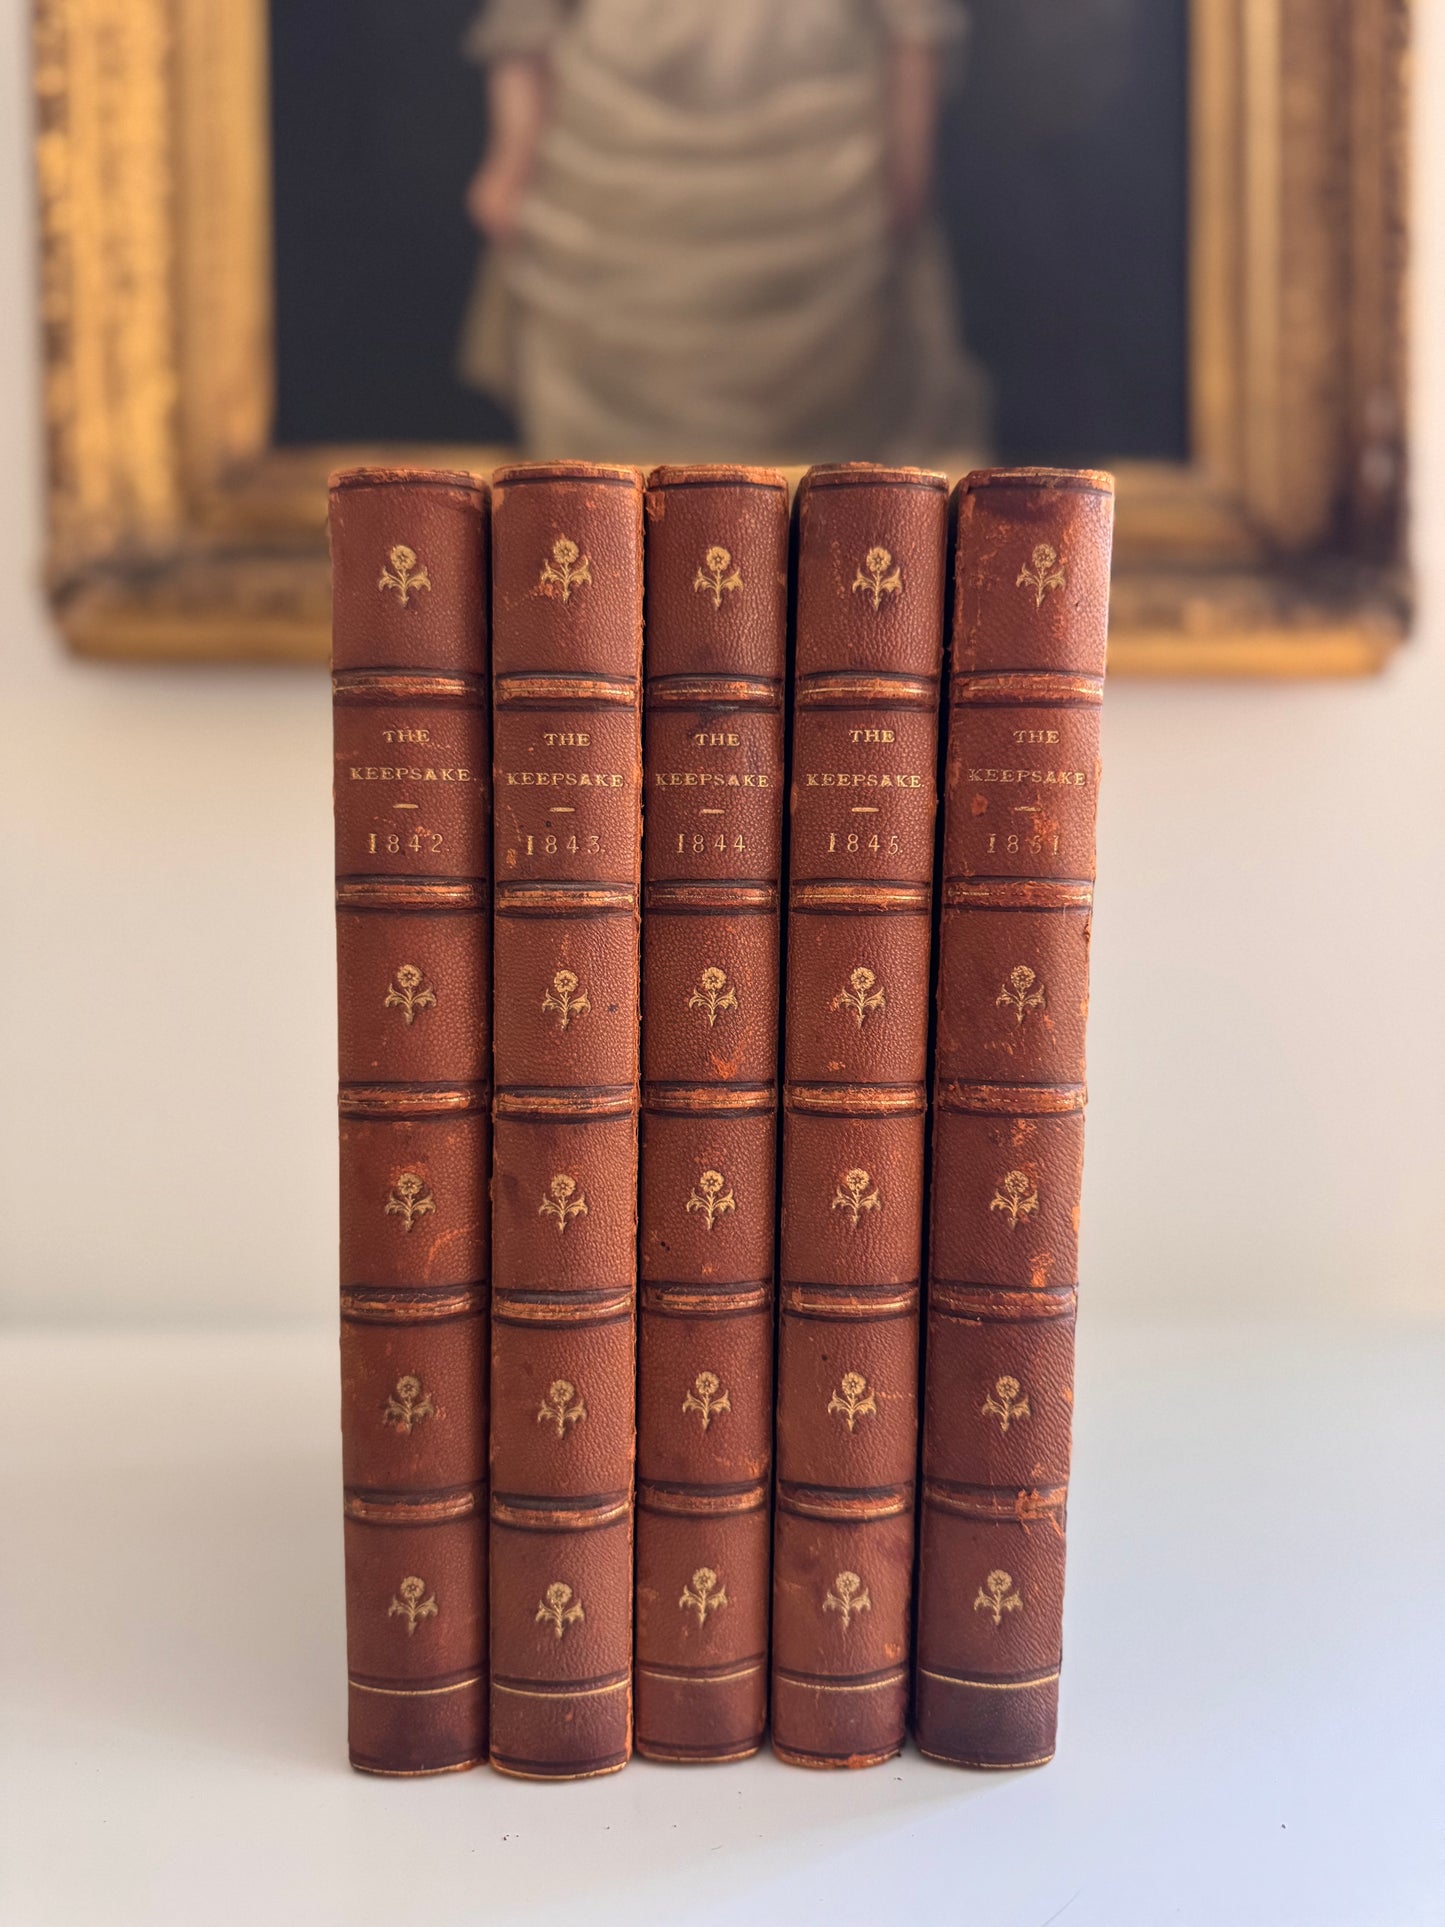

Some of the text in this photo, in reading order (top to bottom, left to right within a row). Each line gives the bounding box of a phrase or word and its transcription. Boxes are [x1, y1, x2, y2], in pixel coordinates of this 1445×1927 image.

[382, 729, 430, 743] THE
[543, 733, 591, 747] THE
[693, 733, 741, 747] THE
[849, 729, 896, 743] THE
[1013, 730, 1060, 744] THE
